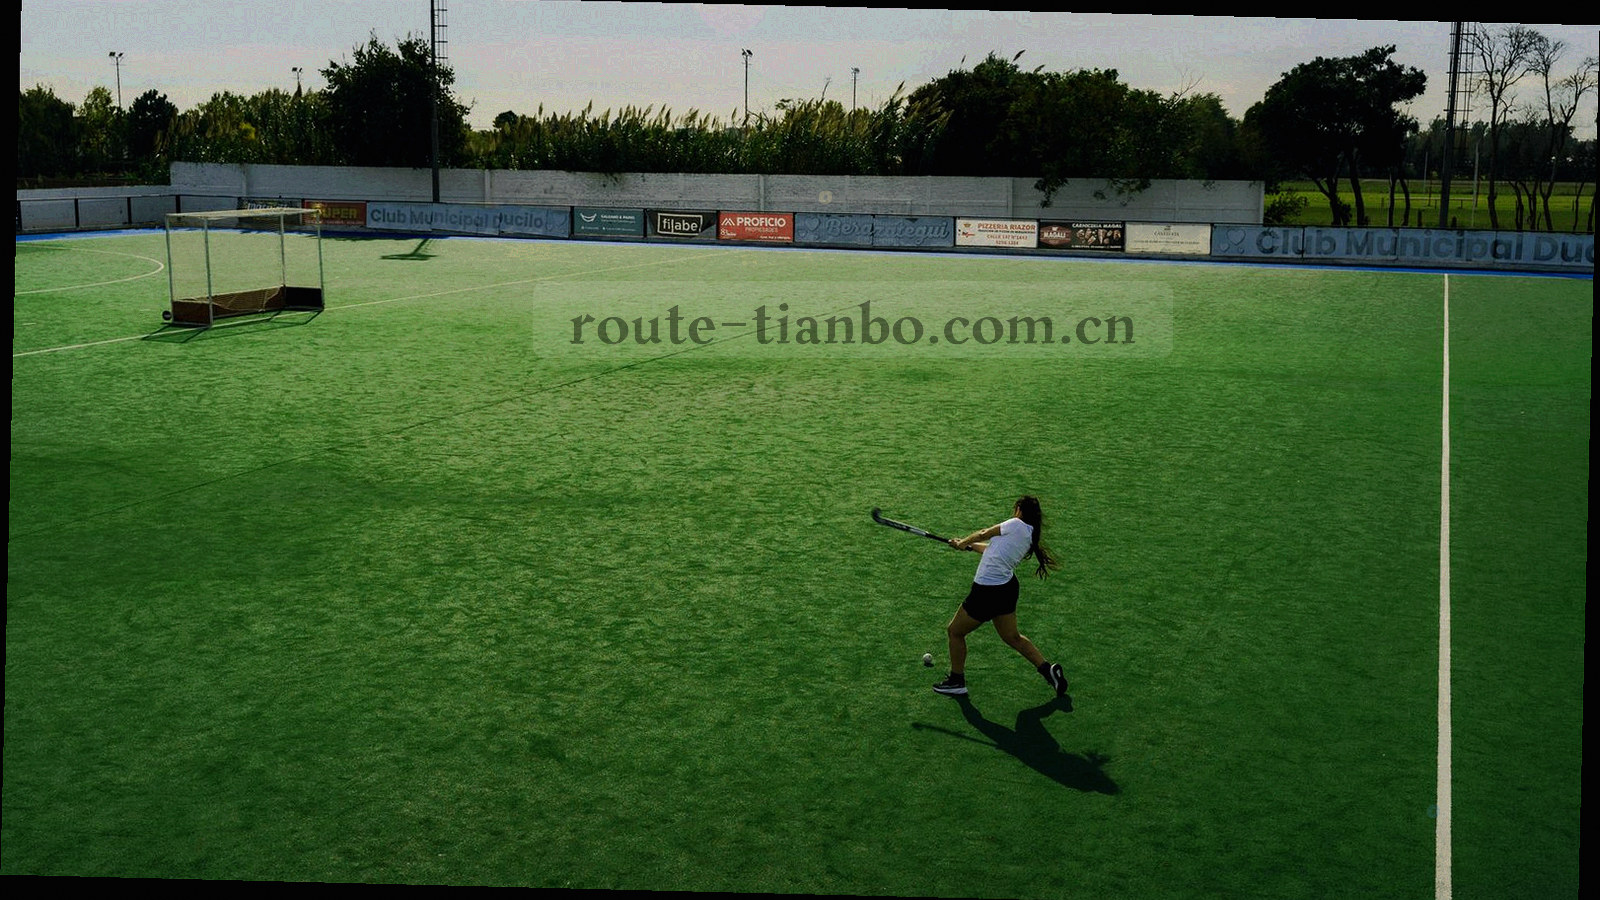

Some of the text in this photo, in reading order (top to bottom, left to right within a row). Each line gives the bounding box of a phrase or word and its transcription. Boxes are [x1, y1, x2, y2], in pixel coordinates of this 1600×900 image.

[370, 208, 407, 224] Club
[410, 209, 488, 229] Municipal
[662, 218, 698, 232] filabe
[736, 216, 786, 227] PROFICIO
[977, 222, 1008, 230] PIZZERIA
[825, 217, 950, 245] Berazategui
[1256, 229, 1336, 255] Club
[1345, 230, 1523, 261] Municipal
